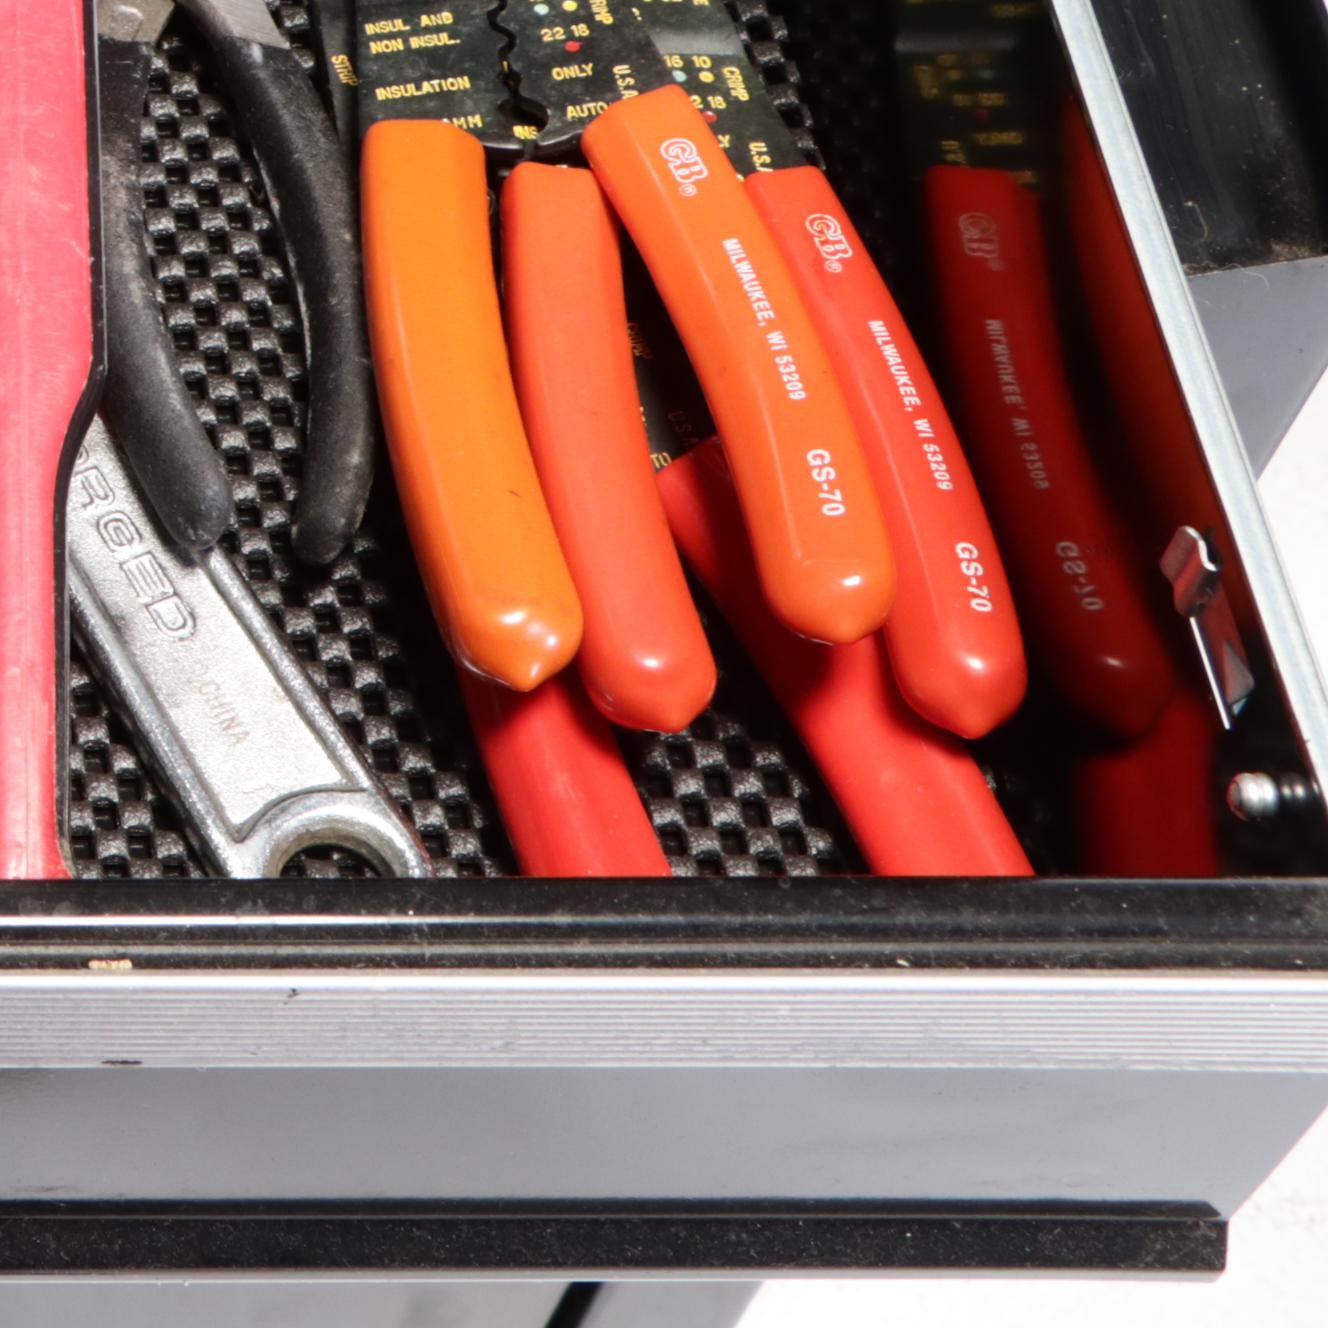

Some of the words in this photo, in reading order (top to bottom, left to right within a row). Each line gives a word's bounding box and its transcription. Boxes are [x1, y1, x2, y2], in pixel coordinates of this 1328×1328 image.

[364, 19, 411, 35] INSUL
[420, 12, 454, 28] AND
[540, 26, 566, 42] 22
[570, 23, 590, 37] 18
[369, 38, 404, 54] NON
[409, 32, 462, 50] INSUL.
[552, 63, 593, 81] ONLY
[664, 55, 685, 68] 16
[692, 55, 713, 69] 10
[375, 76, 472, 101] INSULATION
[722, 66, 750, 102] CRIMP
[707, 96, 727, 109] 18
[722, 237, 776, 327] MILWAUKEE,
[766, 330, 788, 351] WI
[775, 354, 807, 401] 53209
[867, 320, 923, 412] MILWAUKEE,
[913, 418, 935, 439] WI
[923, 442, 953, 490] 53209
[806, 448, 846, 516] GS-70
[74, 445, 196, 642] RGED
[955, 542, 993, 612] GS-70
[198, 679, 250, 745] CHINA
